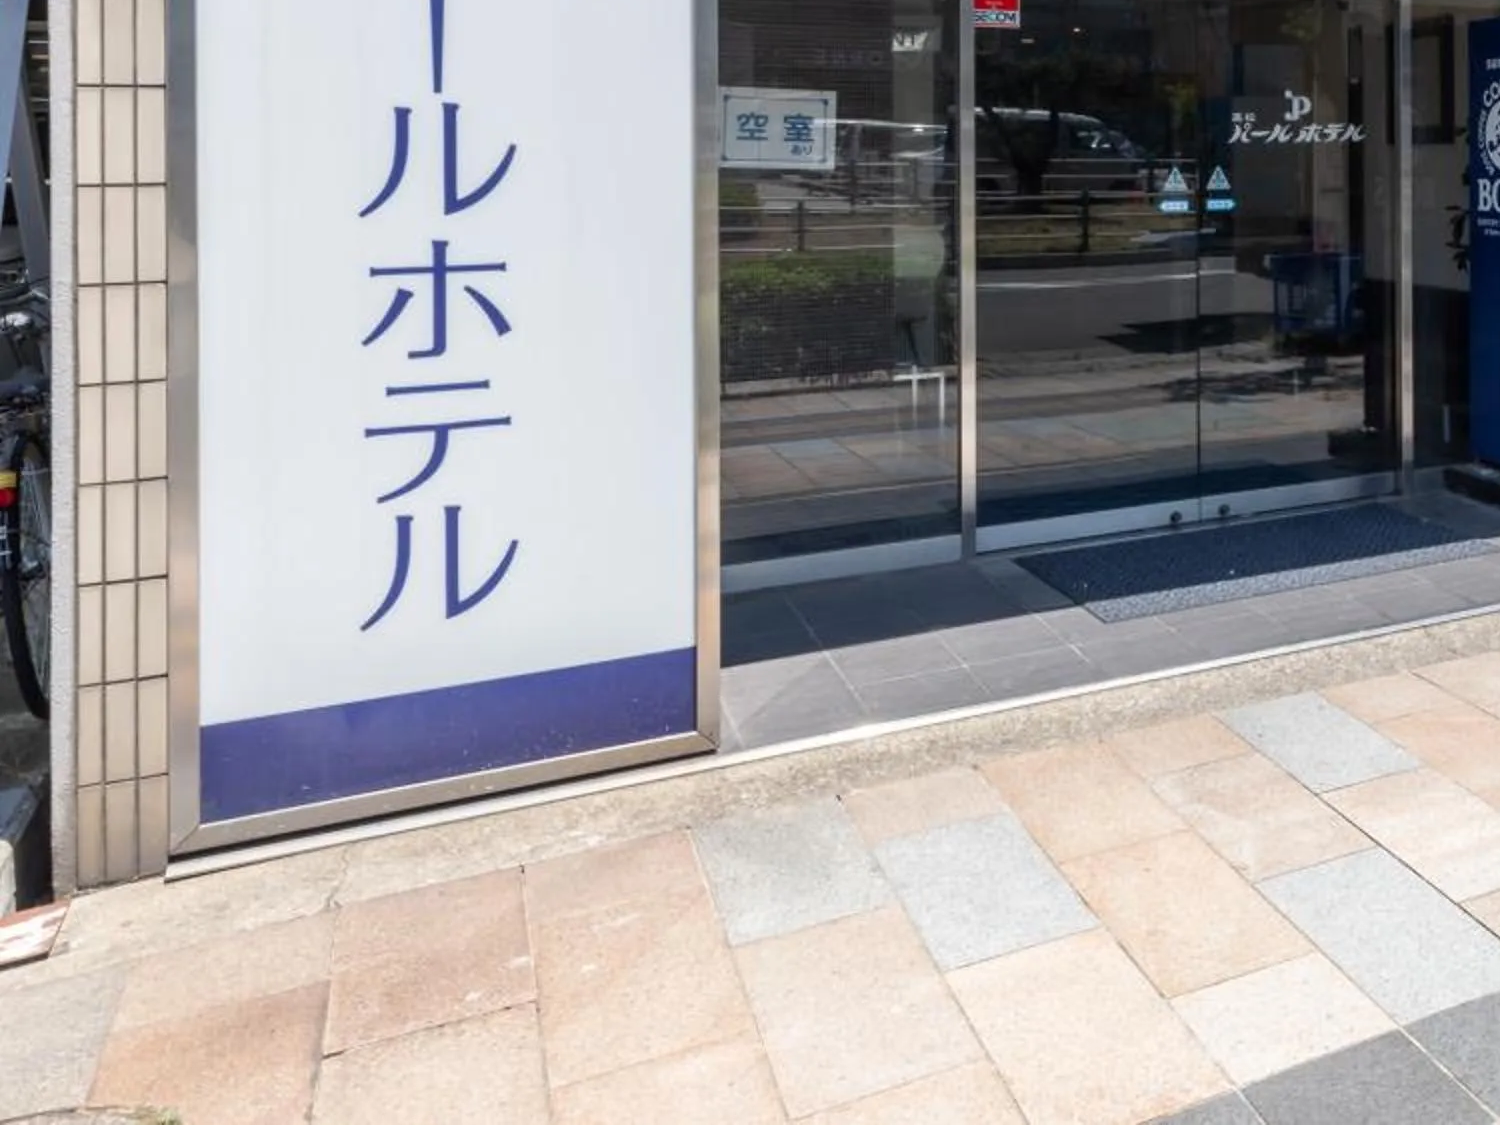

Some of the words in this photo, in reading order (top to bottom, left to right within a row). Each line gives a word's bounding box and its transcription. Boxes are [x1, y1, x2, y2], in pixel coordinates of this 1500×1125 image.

[736, 112, 815, 142] 空室
[1228, 123, 1367, 144] パールホテル
